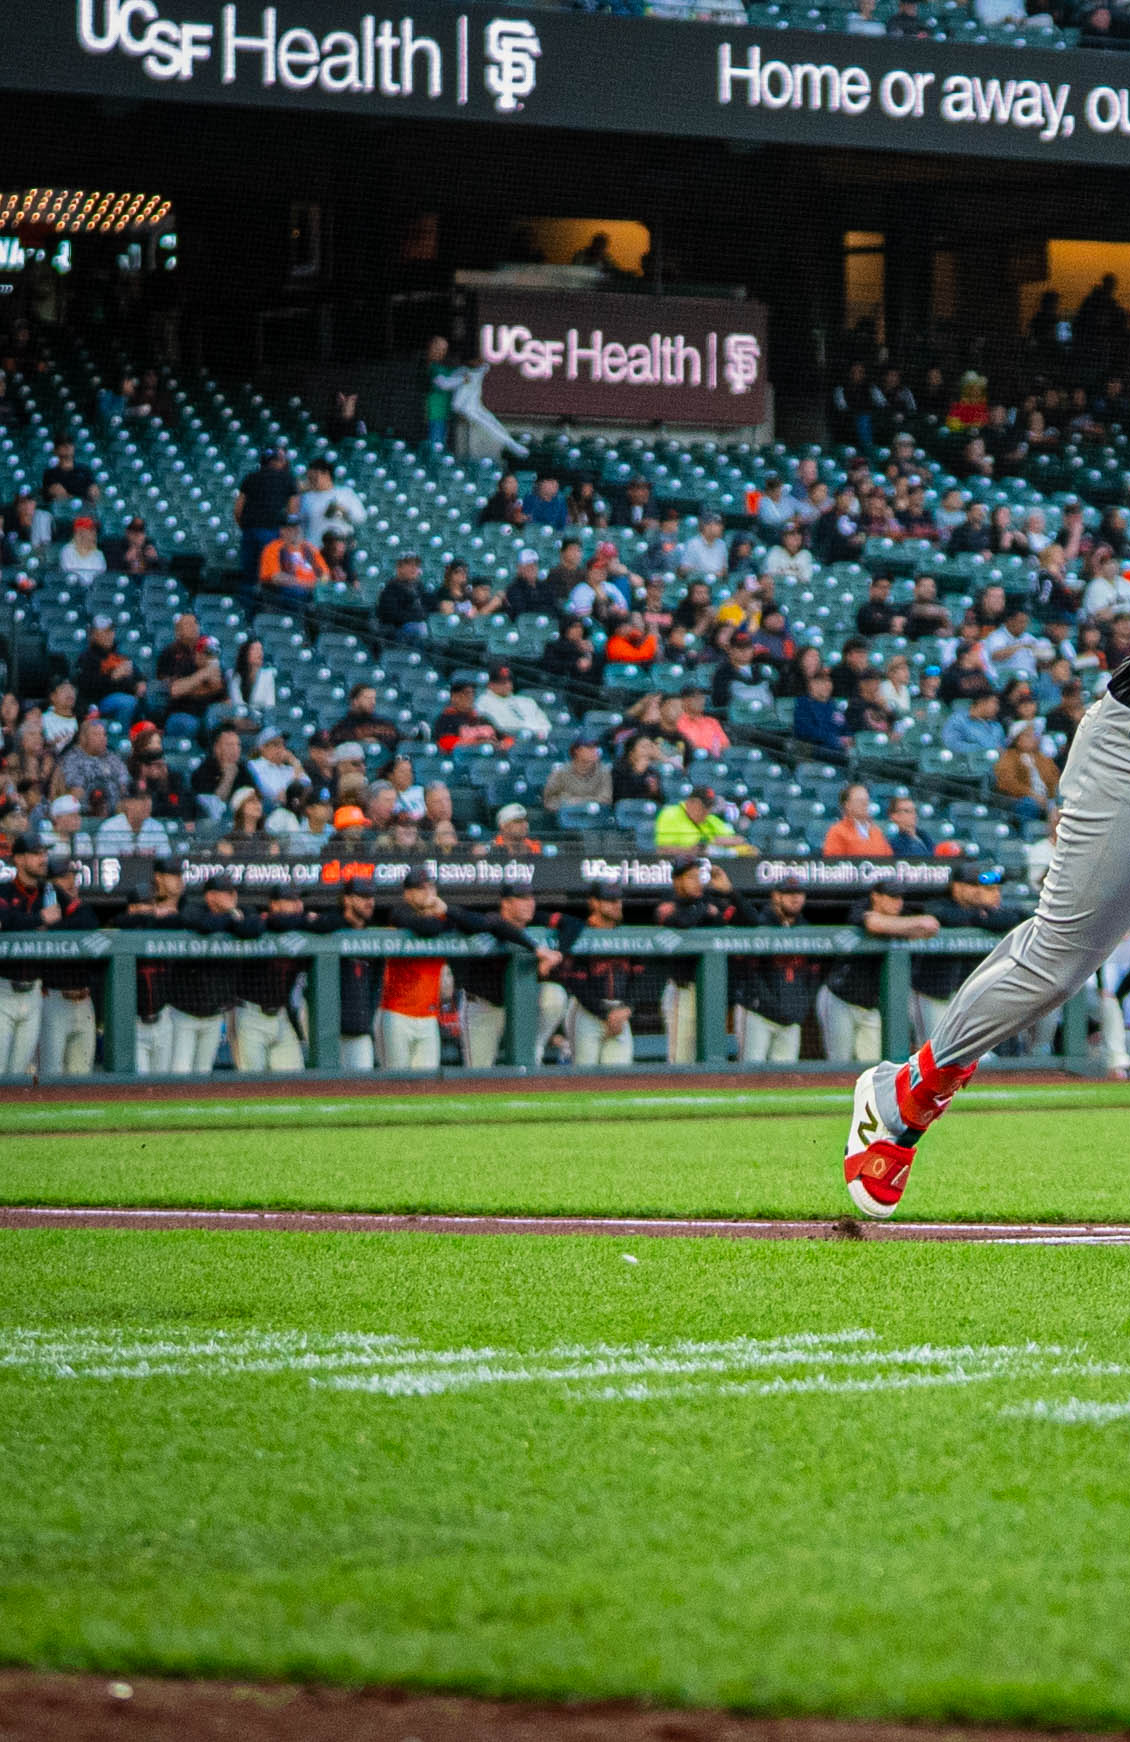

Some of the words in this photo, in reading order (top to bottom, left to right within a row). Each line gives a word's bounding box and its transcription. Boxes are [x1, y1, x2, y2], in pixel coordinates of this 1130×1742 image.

[76, 0, 213, 80] UCSF
[221, 3, 442, 99] Health
[717, 42, 872, 114] Home
[881, 69, 934, 118] or
[941, 75, 1076, 142] away,
[481, 324, 565, 379] UCSF
[566, 328, 702, 386] Health
[245, 864, 291, 886] away,
[292, 864, 321, 884] our
[438, 863, 476, 884] save
[504, 859, 535, 884] day
[621, 859, 673, 884] Healt
[810, 860, 858, 884] Health
[896, 860, 952, 884] Partner
[146, 940, 188, 955] BANK
[209, 940, 278, 955] AMERICA
[342, 938, 382, 953] BANK
[403, 938, 468, 953] AMERICA
[713, 937, 751, 951] BANK
[773, 937, 833, 951] AMERICA
[946, 937, 998, 950] AMERIC
